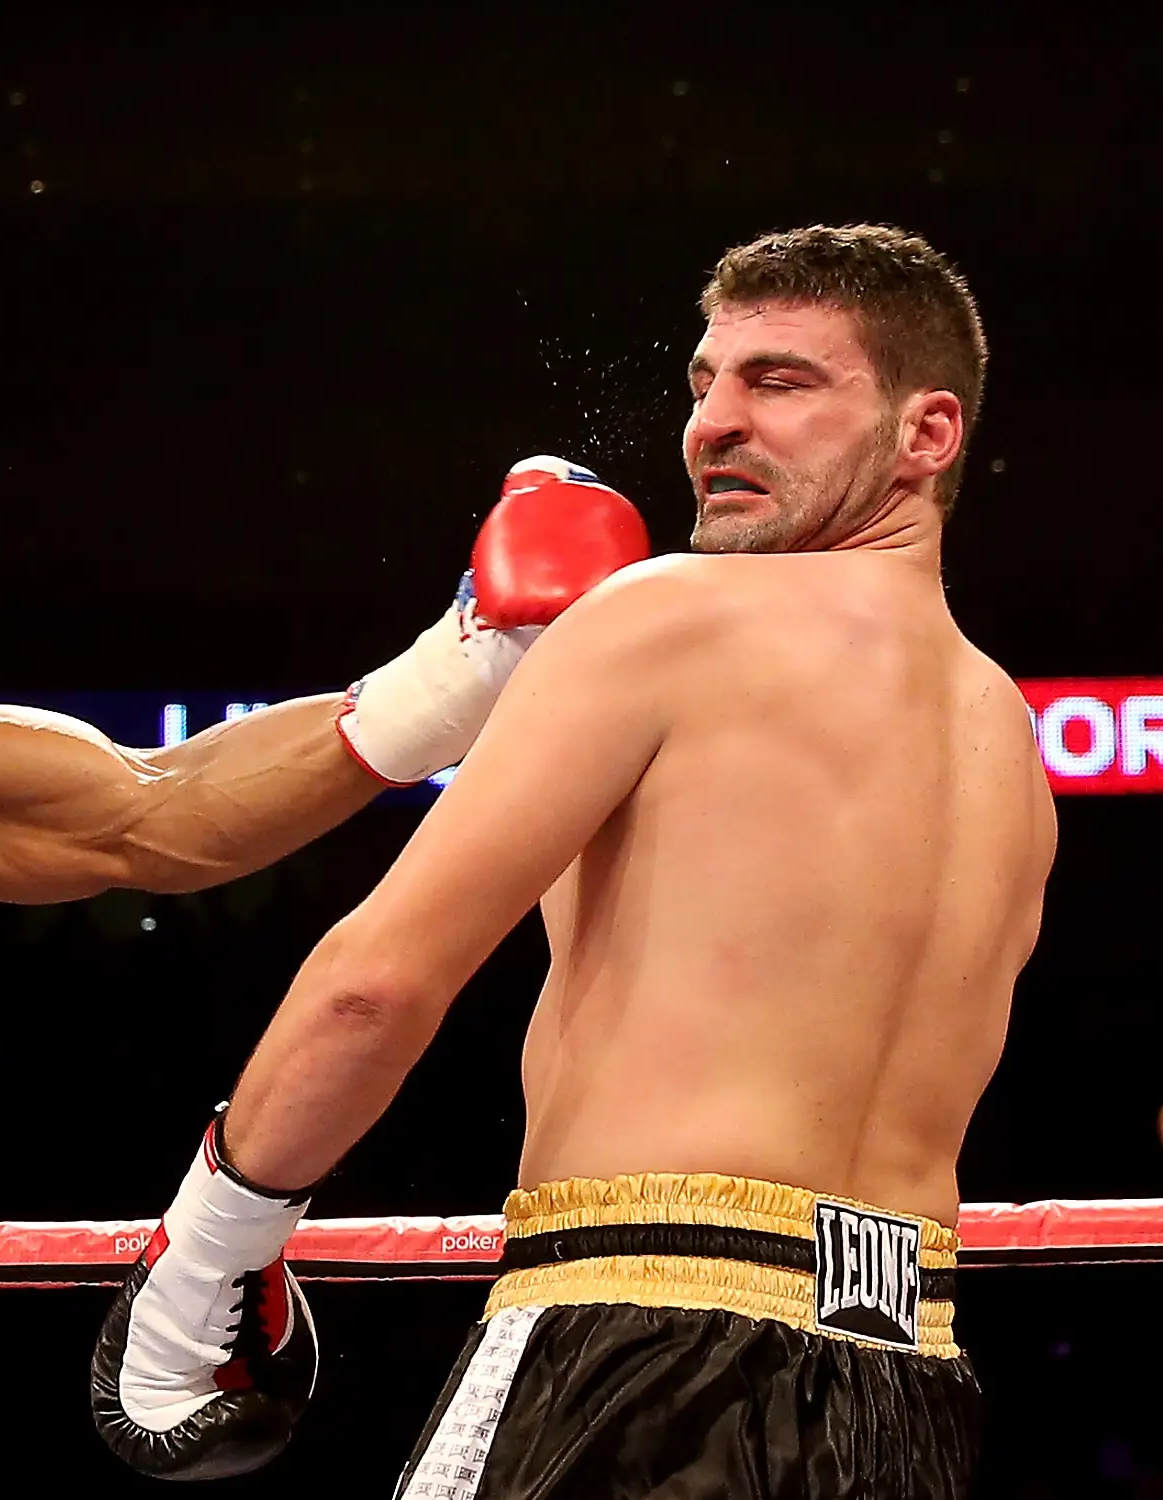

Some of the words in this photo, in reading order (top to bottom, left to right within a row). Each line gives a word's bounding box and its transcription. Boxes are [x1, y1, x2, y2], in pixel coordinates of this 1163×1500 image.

[1030, 695, 1163, 777] OR
[442, 1231, 500, 1254] poker
[820, 1207, 917, 1340] LEONE
